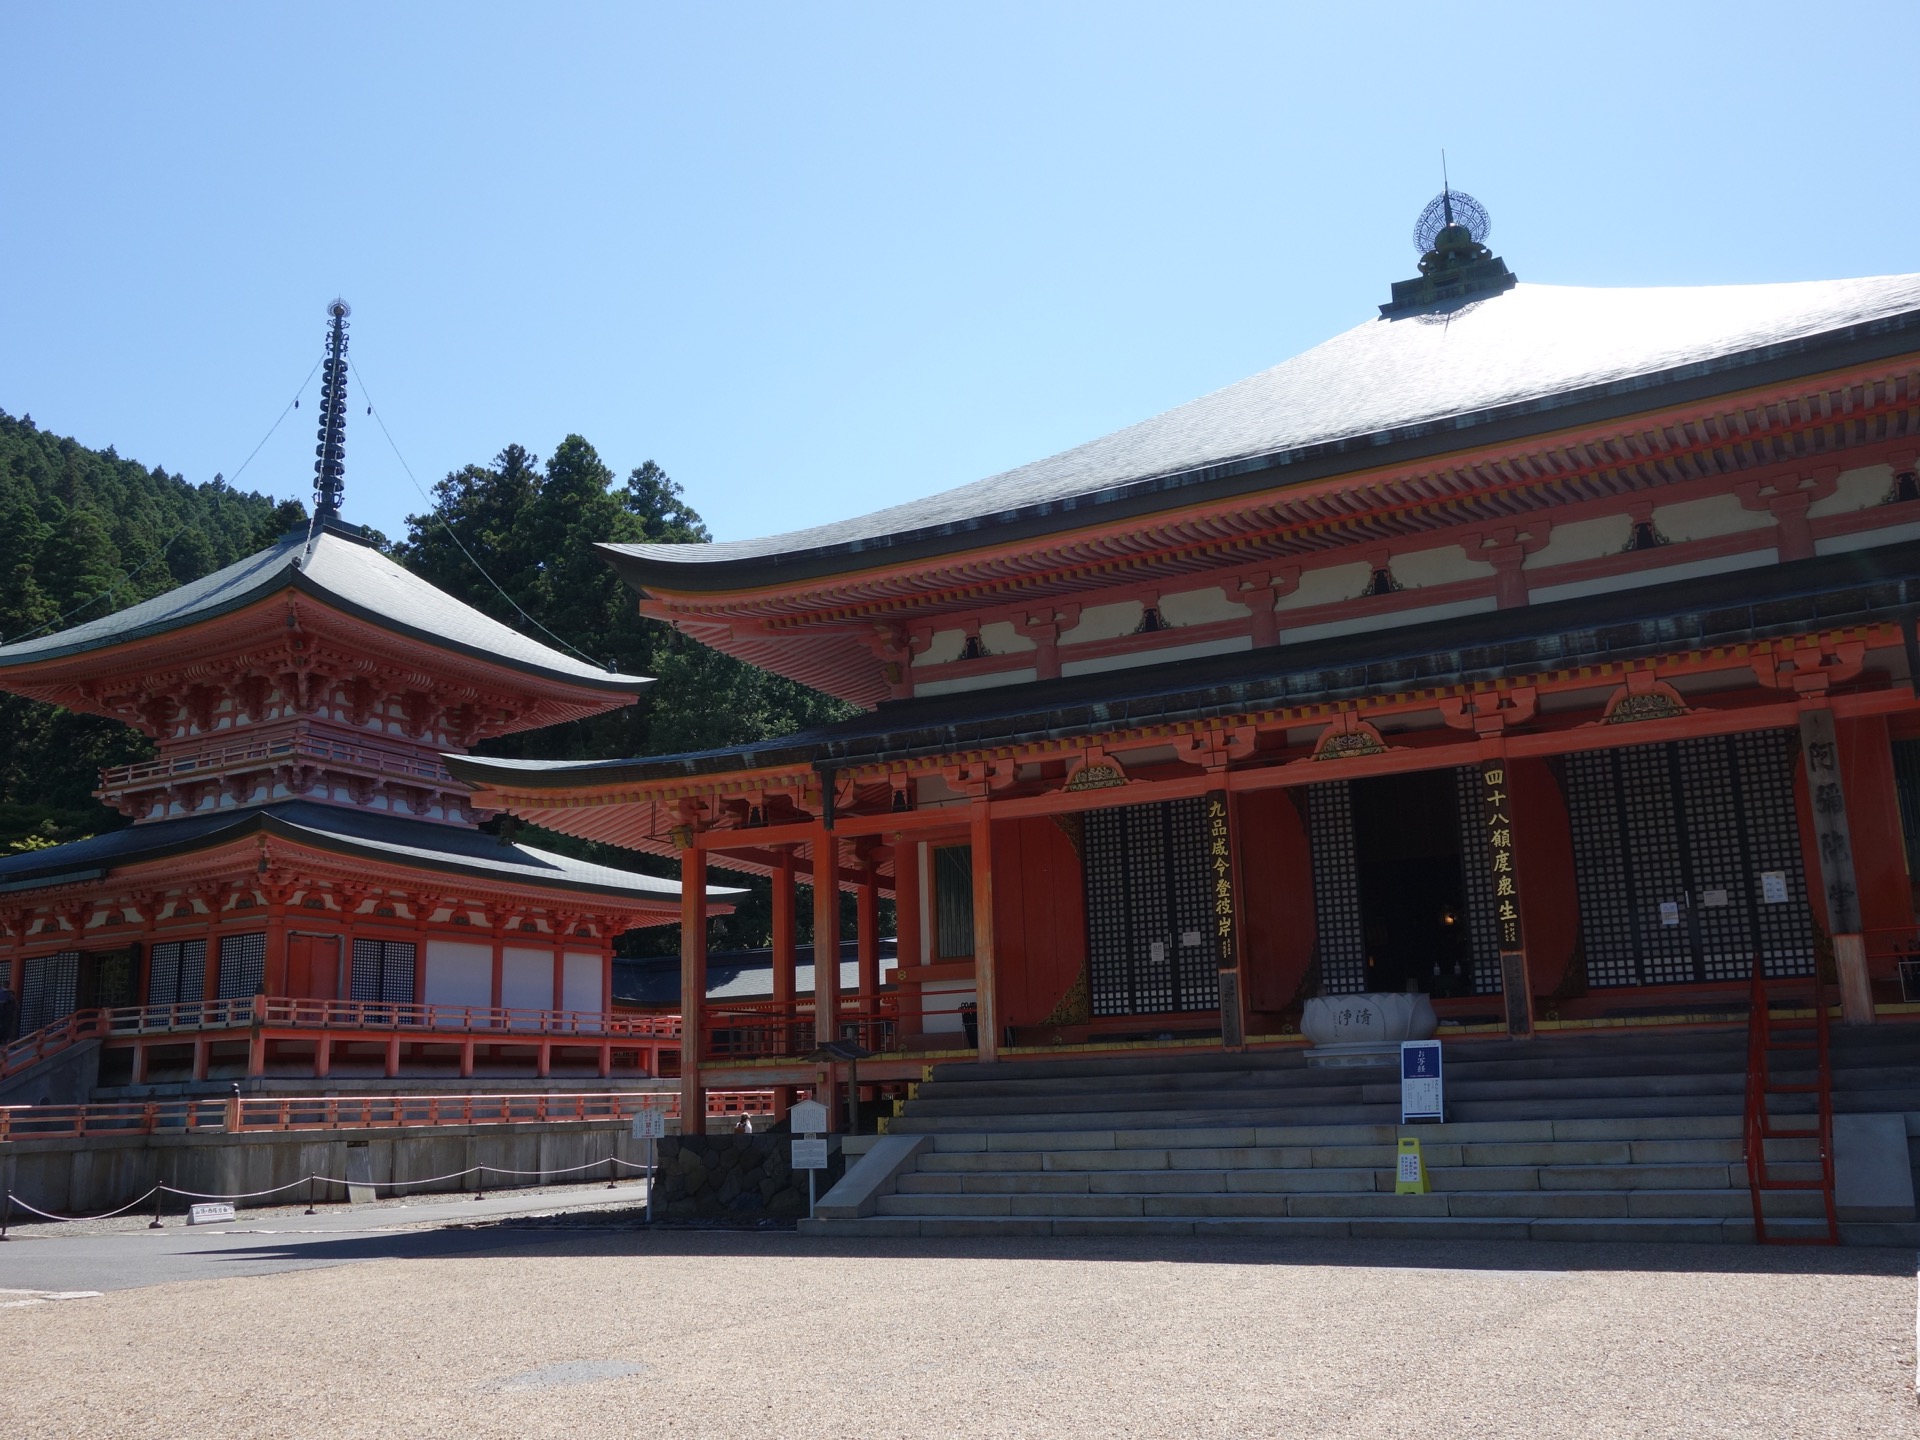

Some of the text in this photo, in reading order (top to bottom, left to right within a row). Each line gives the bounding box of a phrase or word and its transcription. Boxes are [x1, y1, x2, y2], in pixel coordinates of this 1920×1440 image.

[1208, 800, 1234, 938] 九品咸令登彼岸
[1417, 1050, 1427, 1073] お写経
